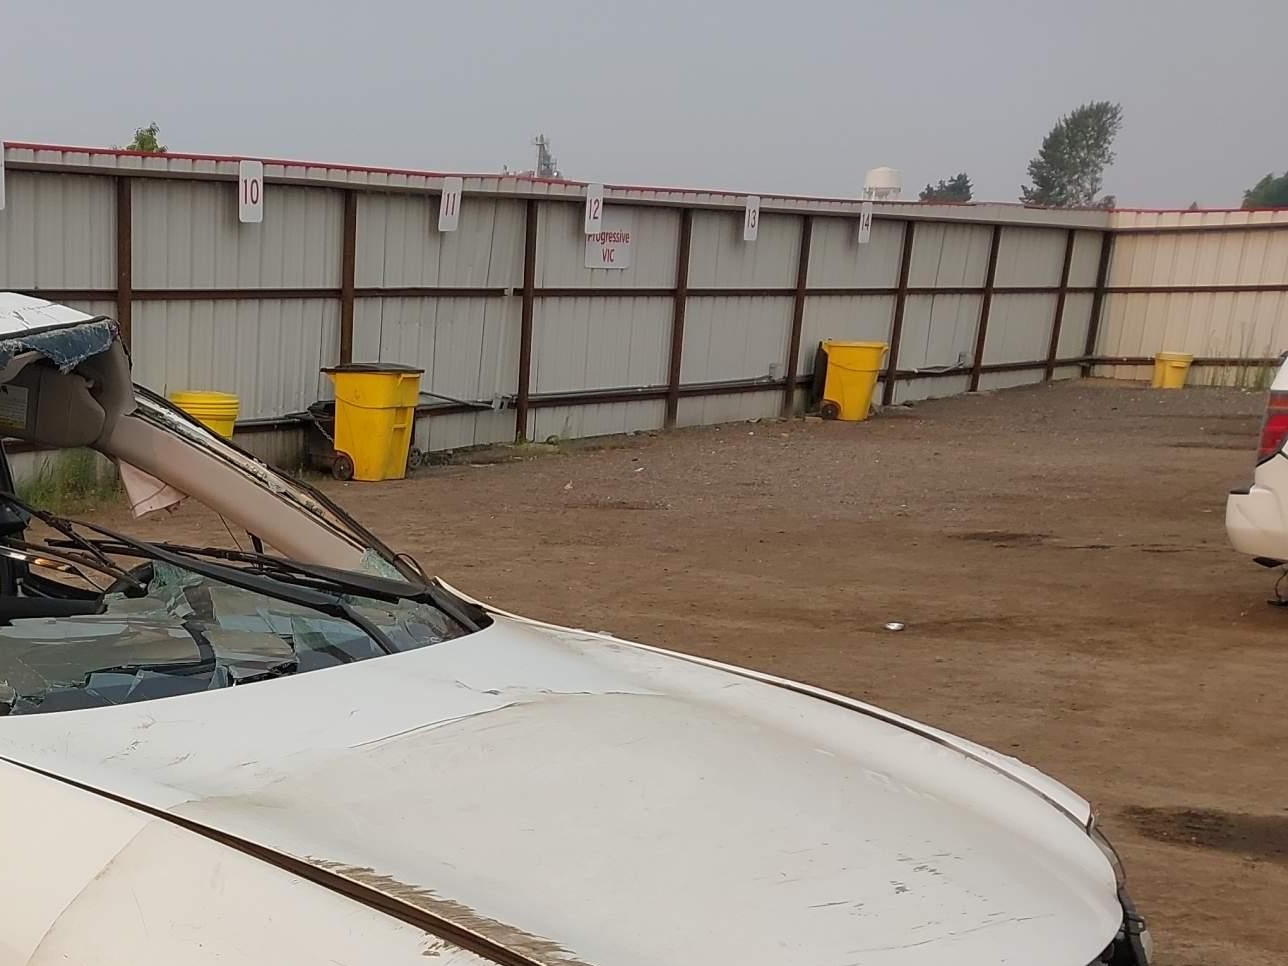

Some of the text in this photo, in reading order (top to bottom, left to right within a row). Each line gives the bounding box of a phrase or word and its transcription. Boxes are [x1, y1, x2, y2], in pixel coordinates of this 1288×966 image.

[243, 178, 260, 205] 10
[445, 191, 457, 217] 11
[588, 198, 601, 220] 12
[747, 208, 757, 228] 13
[861, 213, 870, 231] 14
[602, 248, 616, 263] VIC
